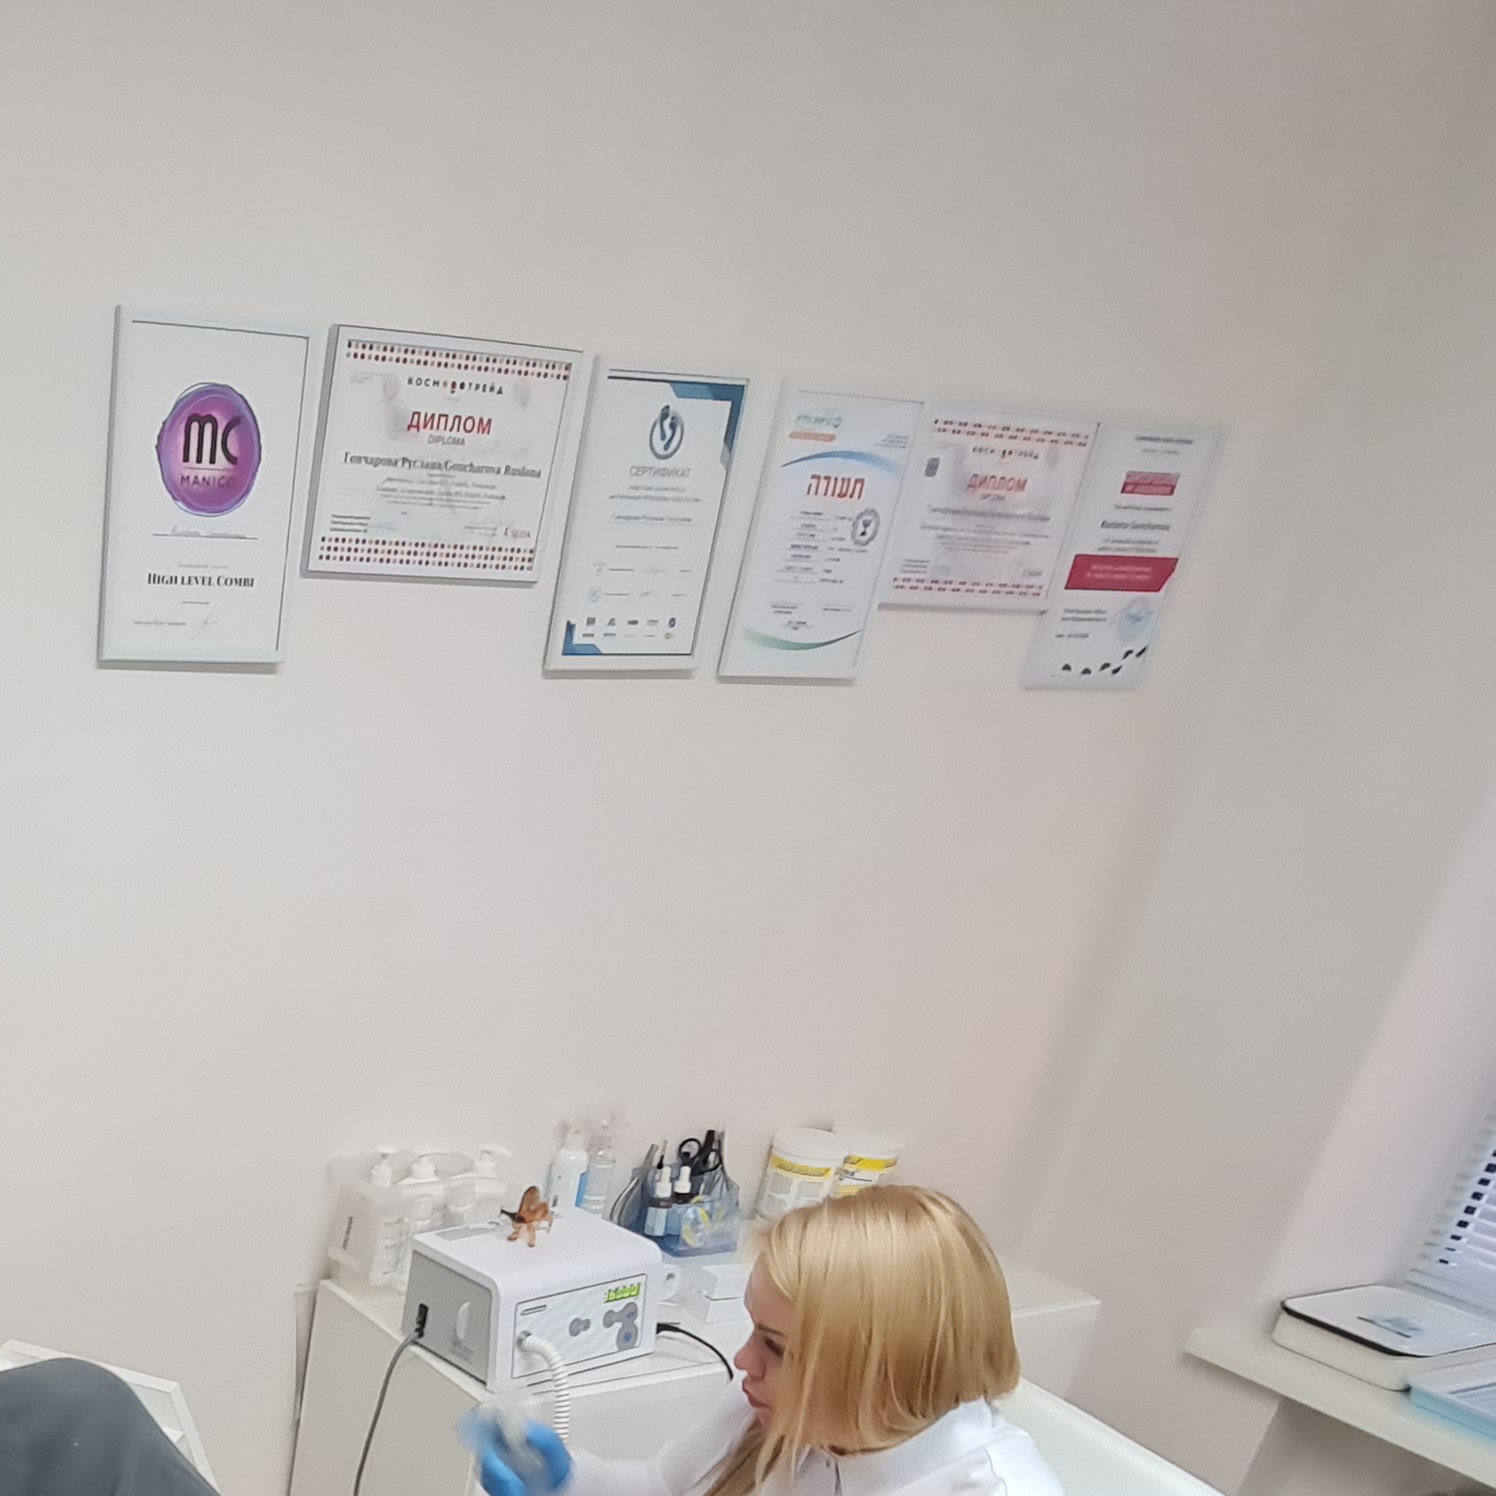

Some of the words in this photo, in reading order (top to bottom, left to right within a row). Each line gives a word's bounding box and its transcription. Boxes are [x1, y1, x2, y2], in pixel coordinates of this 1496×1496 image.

[407, 411, 493, 435] ДИПЛОМ
[806, 474, 866, 499] תעודה
[966, 473, 1028, 494] ДИПЛОМ
